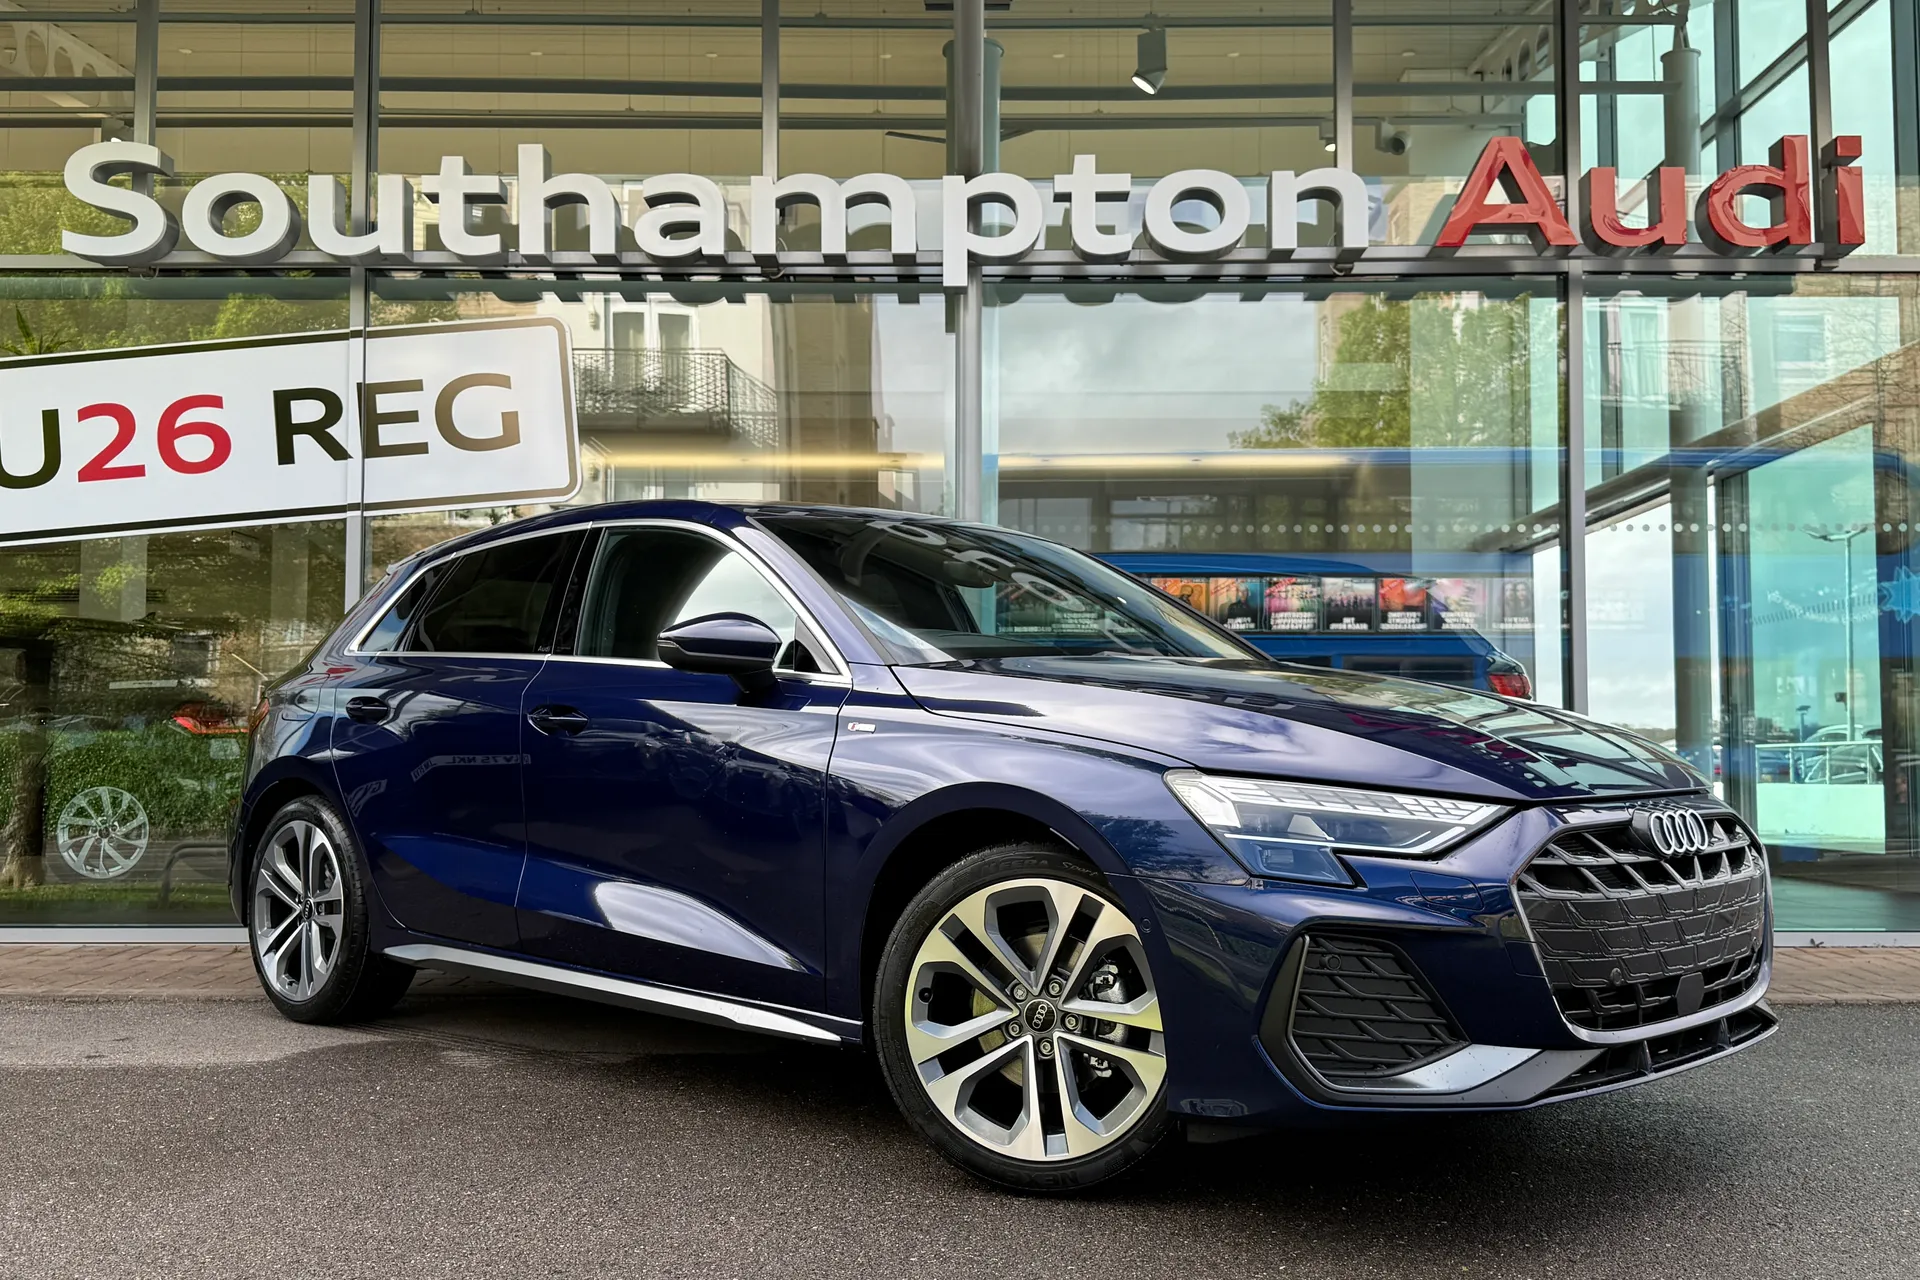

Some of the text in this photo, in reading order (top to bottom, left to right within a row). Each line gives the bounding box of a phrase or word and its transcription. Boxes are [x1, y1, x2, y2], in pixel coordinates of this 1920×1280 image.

[62, 135, 1865, 288] Southampton Audi
[273, 373, 521, 466] REG
